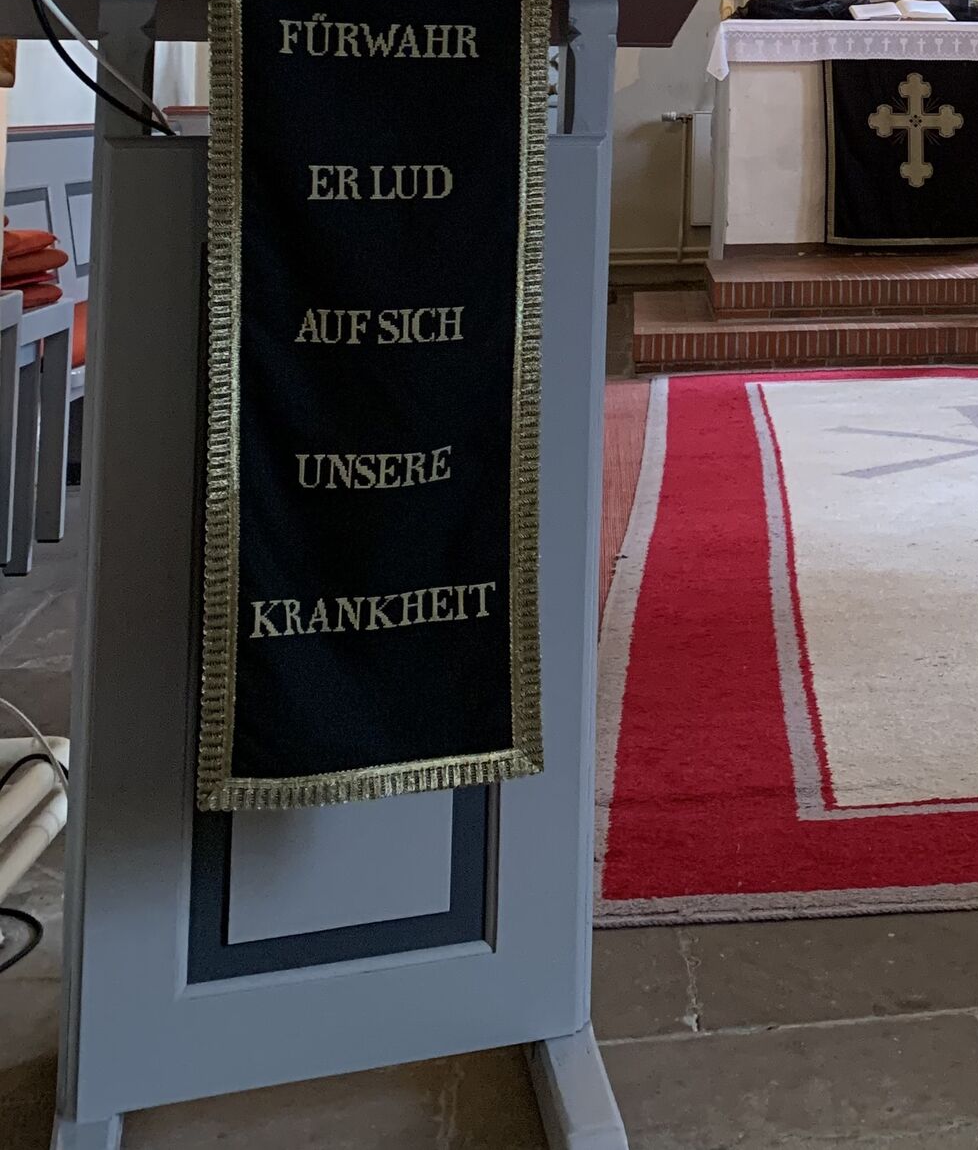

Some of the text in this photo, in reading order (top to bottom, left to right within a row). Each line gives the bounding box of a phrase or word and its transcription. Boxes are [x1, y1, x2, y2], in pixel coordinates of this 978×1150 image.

[279, 13, 479, 58] FÜRWAHR
[307, 165, 453, 200] ER LUD
[294, 306, 465, 345] AUF SICH
[295, 445, 452, 489] UNSERE
[249, 581, 496, 639] KRANKHEIT
